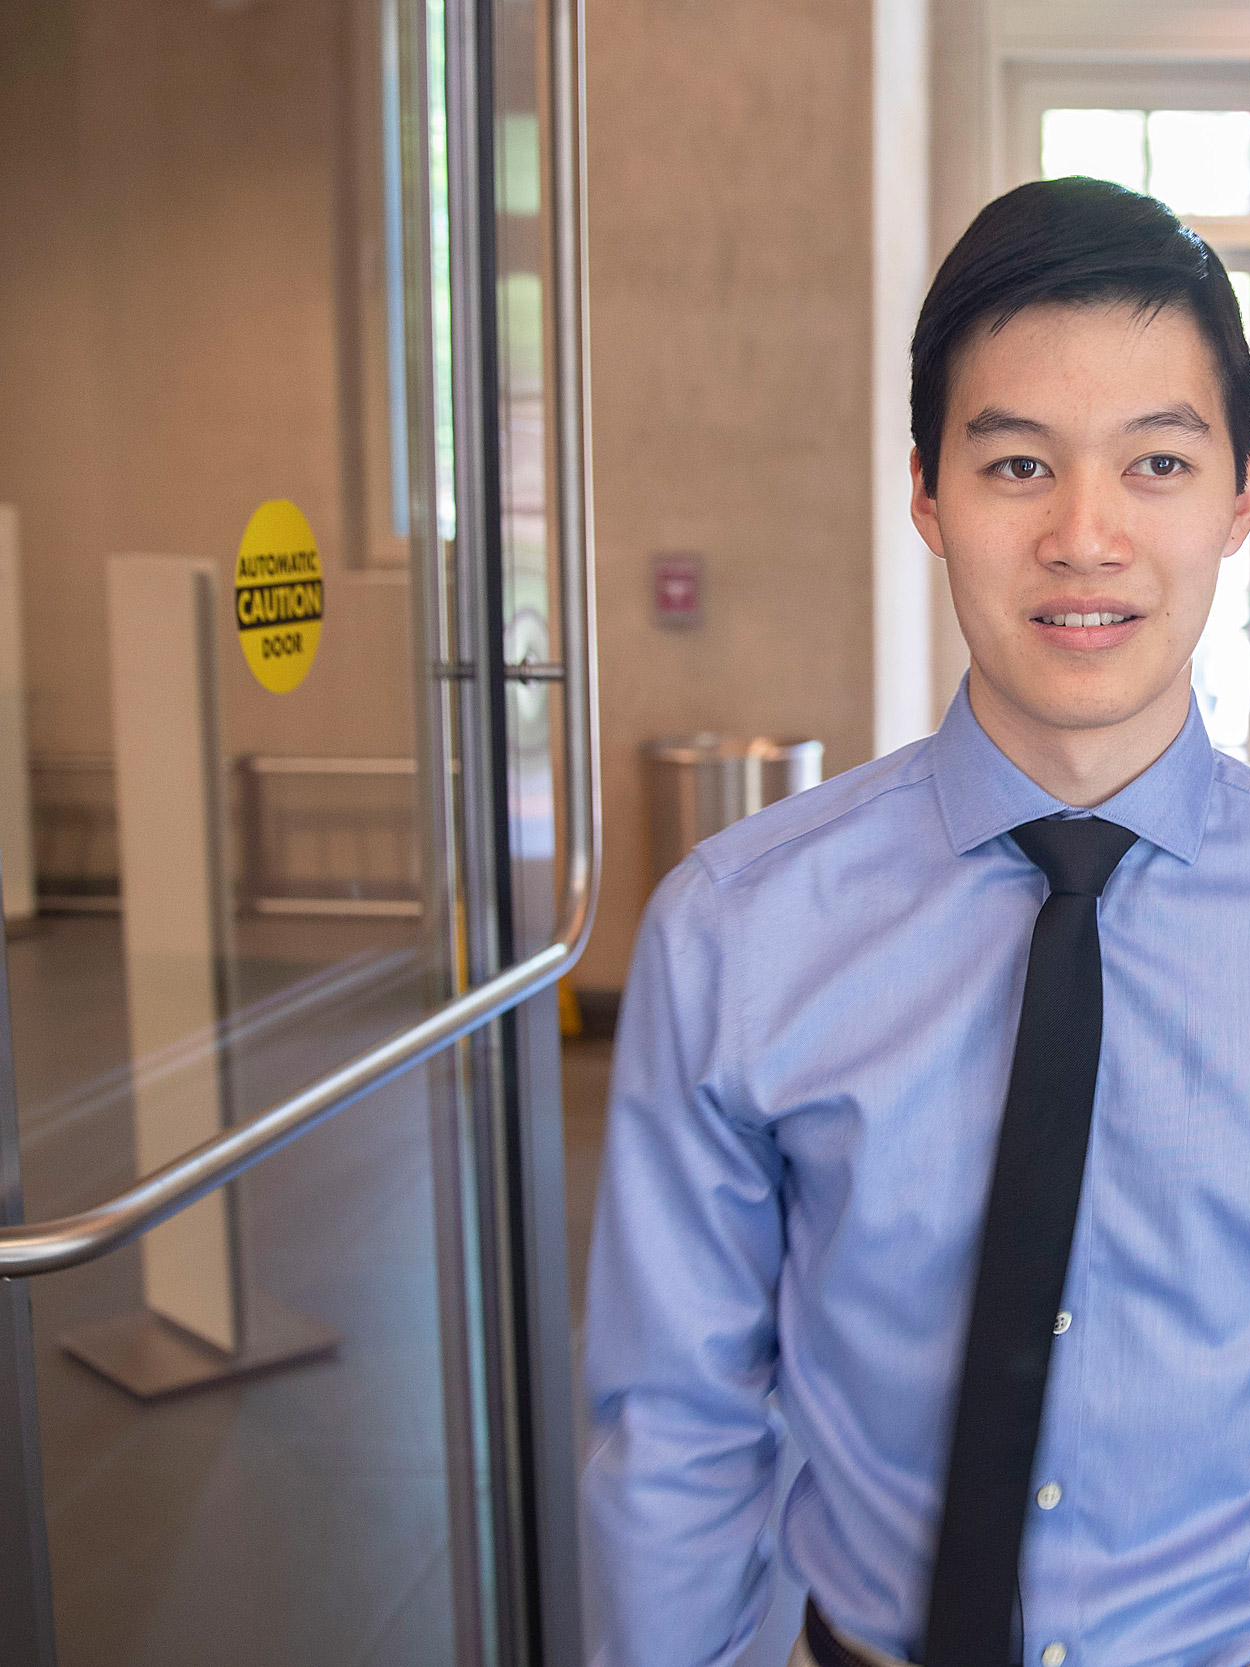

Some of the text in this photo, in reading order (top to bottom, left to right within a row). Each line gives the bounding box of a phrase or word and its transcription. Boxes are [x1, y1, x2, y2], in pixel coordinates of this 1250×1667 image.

[239, 552, 317, 578] AUTOMATIC
[238, 584, 322, 625] CAUTION
[262, 632, 303, 659] DOOR
